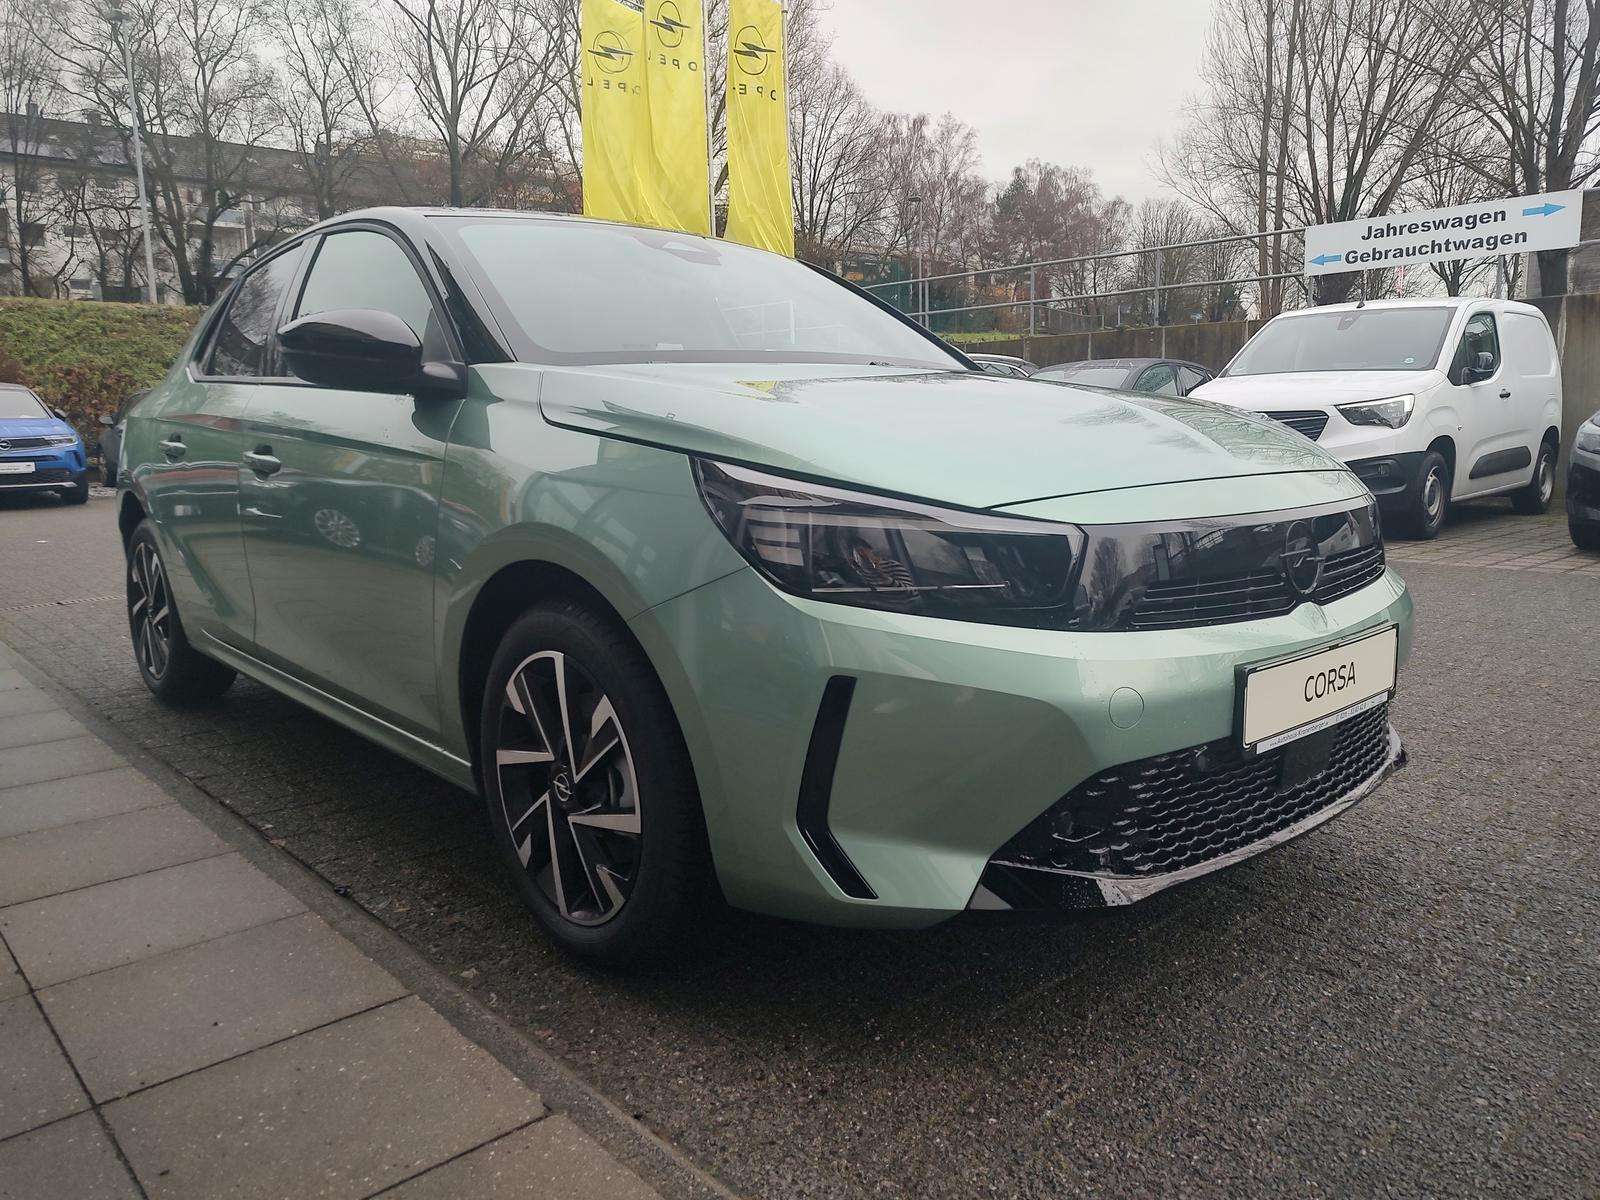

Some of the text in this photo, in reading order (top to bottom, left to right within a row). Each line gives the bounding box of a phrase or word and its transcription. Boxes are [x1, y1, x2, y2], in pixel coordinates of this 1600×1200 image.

[1361, 208, 1507, 241] Jahreswagen
[1344, 229, 1528, 265] Gebrauchtwagen
[1304, 661, 1356, 702] CORSA
